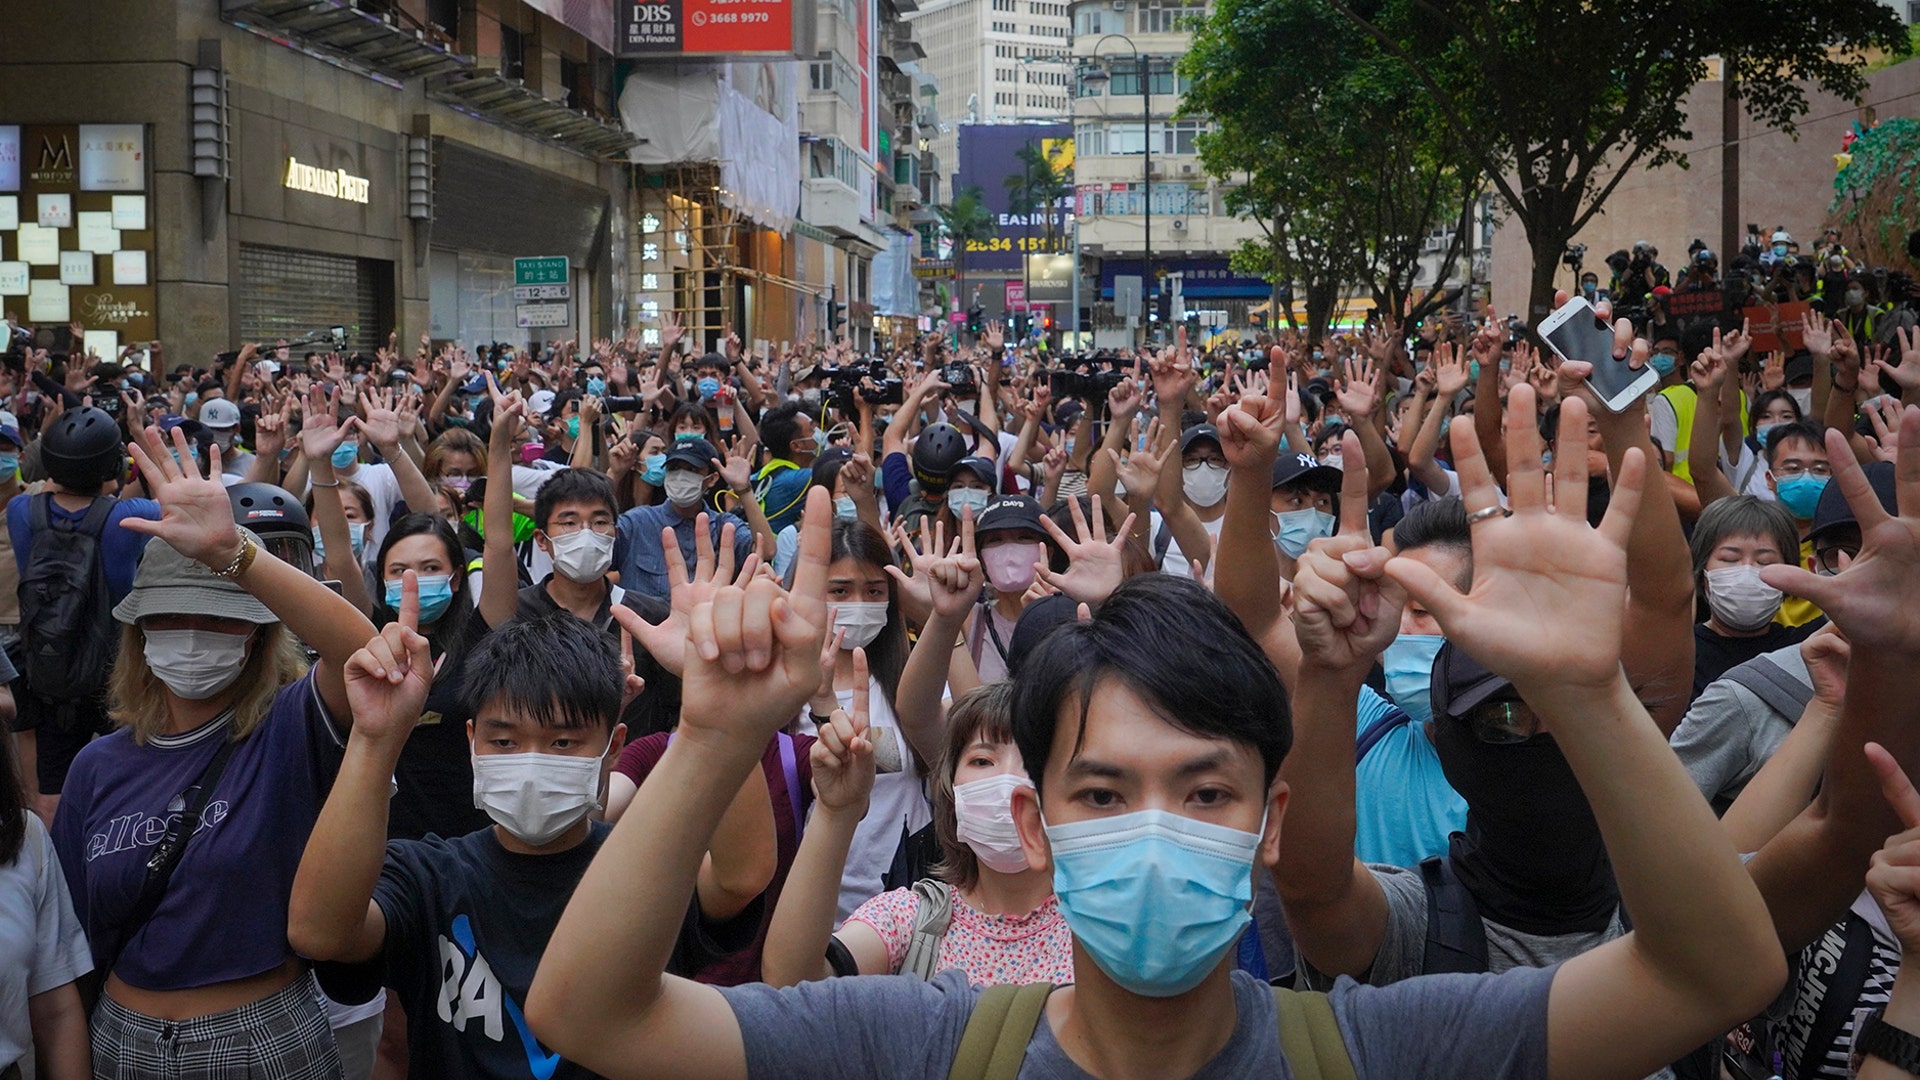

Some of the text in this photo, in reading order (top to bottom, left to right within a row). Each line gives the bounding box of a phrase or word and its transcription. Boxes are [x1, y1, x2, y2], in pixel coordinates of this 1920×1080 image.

[633, 4, 672, 22] DBS
[710, 12, 769, 23] 3668 9970
[629, 23, 675, 35] 星展財務
[338, 168, 370, 204] PIGUET
[537, 260, 564, 269] STAND
[524, 270, 559, 281] 的士站
[1181, 269, 1228, 280] 港賽馬會
[560, 286, 567, 296] 6
[1296, 453, 1319, 468] NY
[1002, 500, 1025, 508] DAYS
